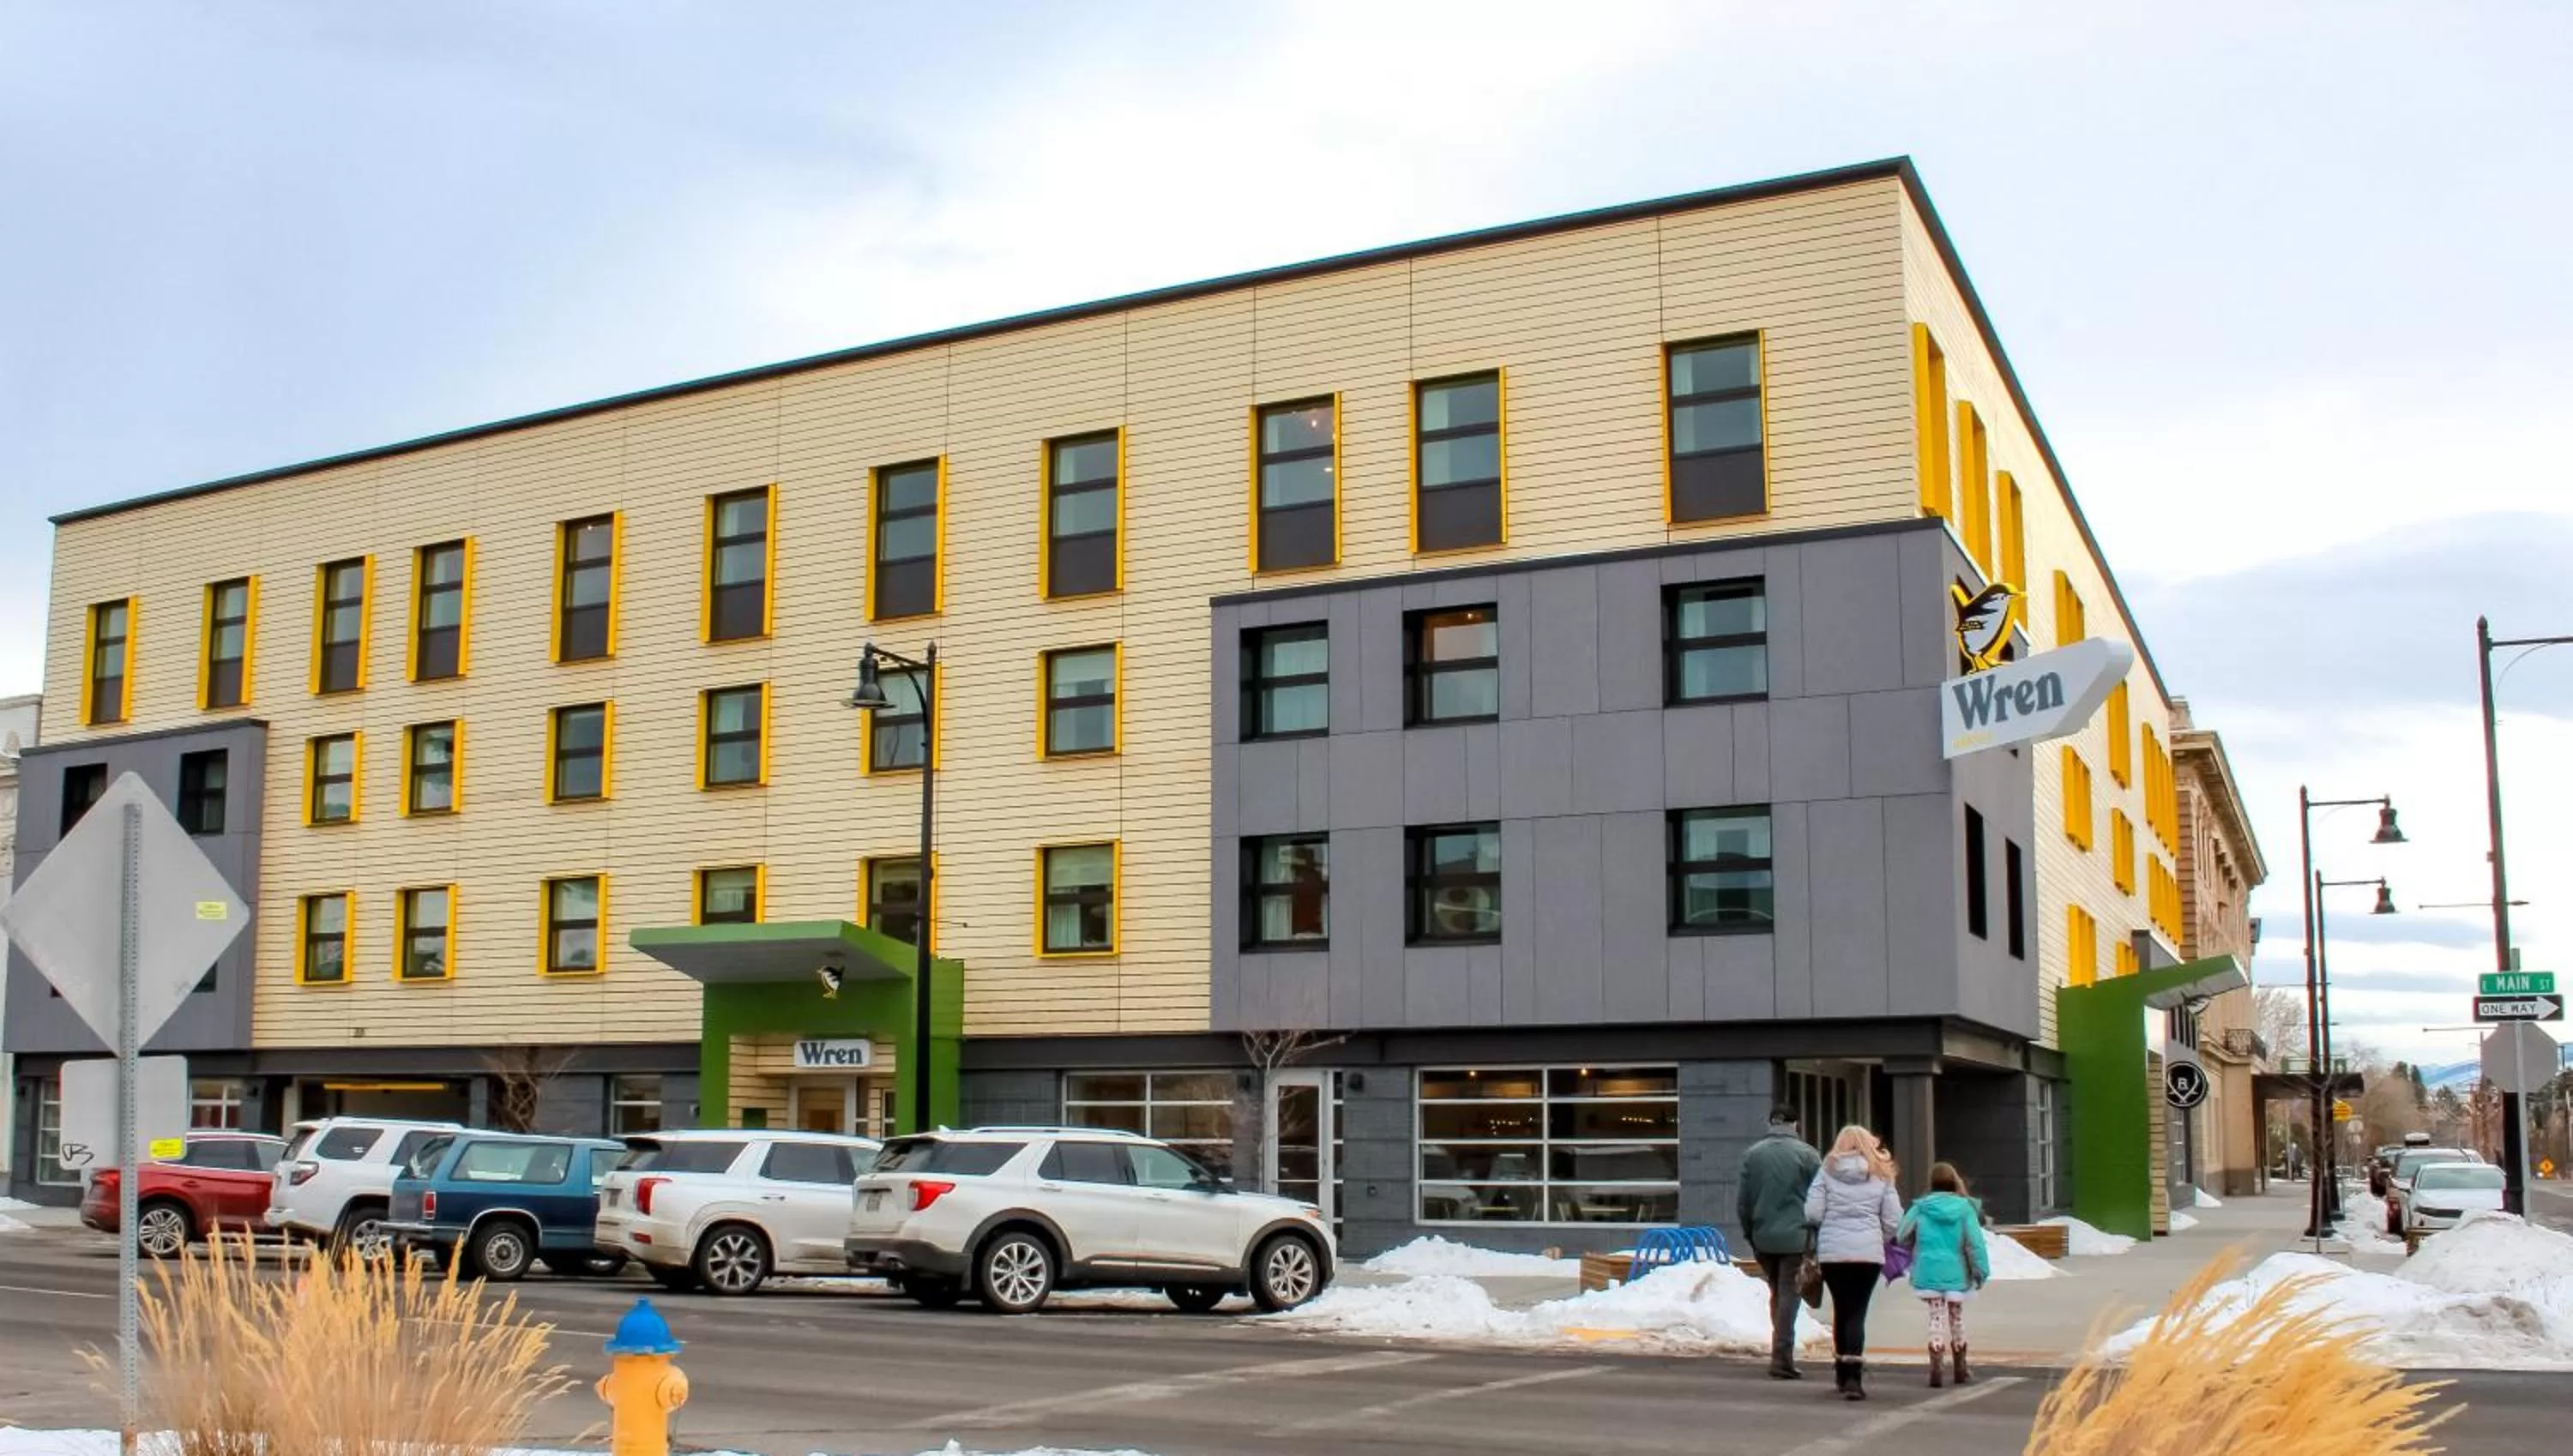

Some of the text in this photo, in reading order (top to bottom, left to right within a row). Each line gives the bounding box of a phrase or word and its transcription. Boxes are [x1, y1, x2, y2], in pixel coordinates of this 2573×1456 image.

[1952, 671, 2064, 730] Wren
[2497, 975, 2529, 991] MAIN
[2540, 979, 2551, 990] ST
[2482, 1003, 2536, 1014] ONE WAY
[799, 1042, 863, 1065] Wren
